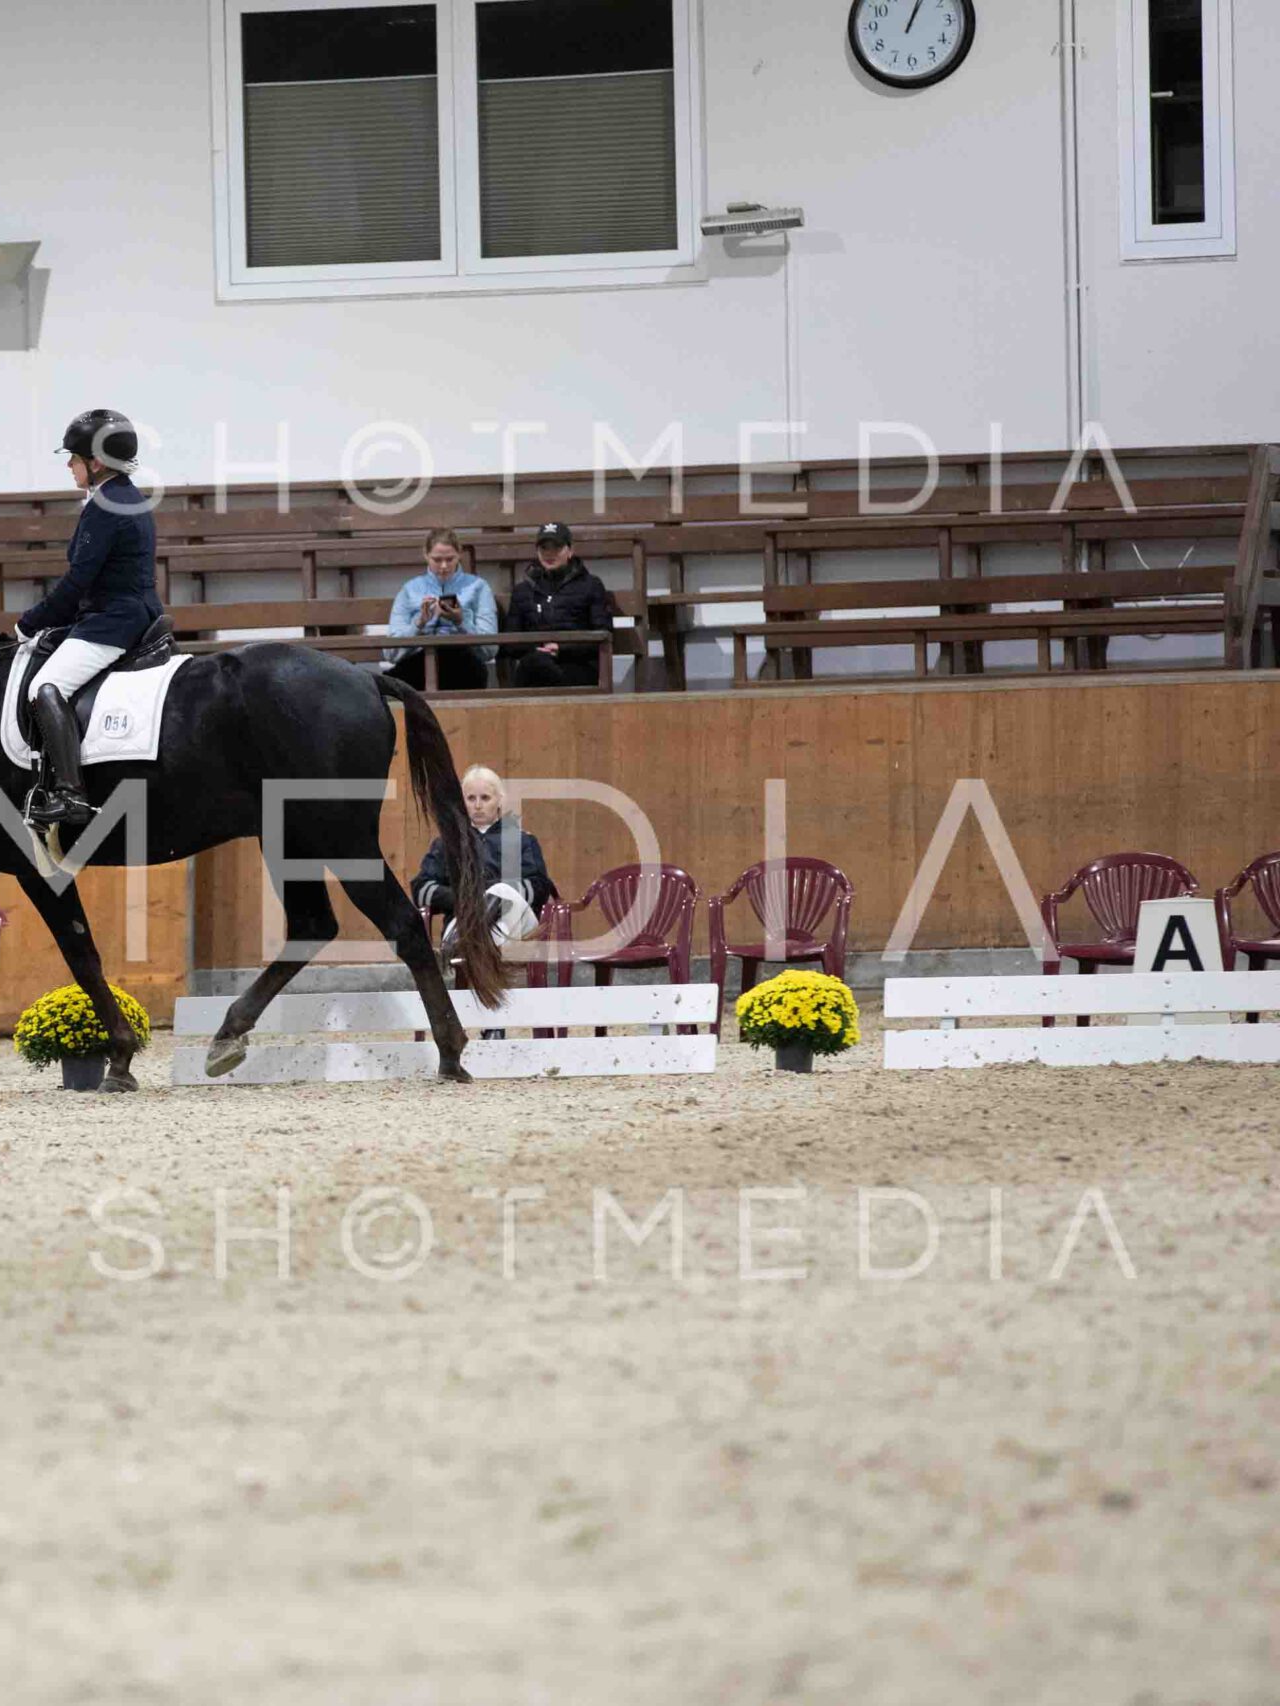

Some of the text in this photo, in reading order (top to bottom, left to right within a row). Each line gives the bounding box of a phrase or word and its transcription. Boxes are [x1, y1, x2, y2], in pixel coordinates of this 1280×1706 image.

[874, 4, 888, 18] 10
[944, 13, 952, 26] 3
[868, 21, 878, 33] 9
[875, 38, 884, 52] 8
[938, 32, 947, 44] 4
[891, 50, 899, 63] 7
[907, 53, 917, 67] 6
[927, 46, 936, 60] 5
[1150, 915, 1205, 971] A
